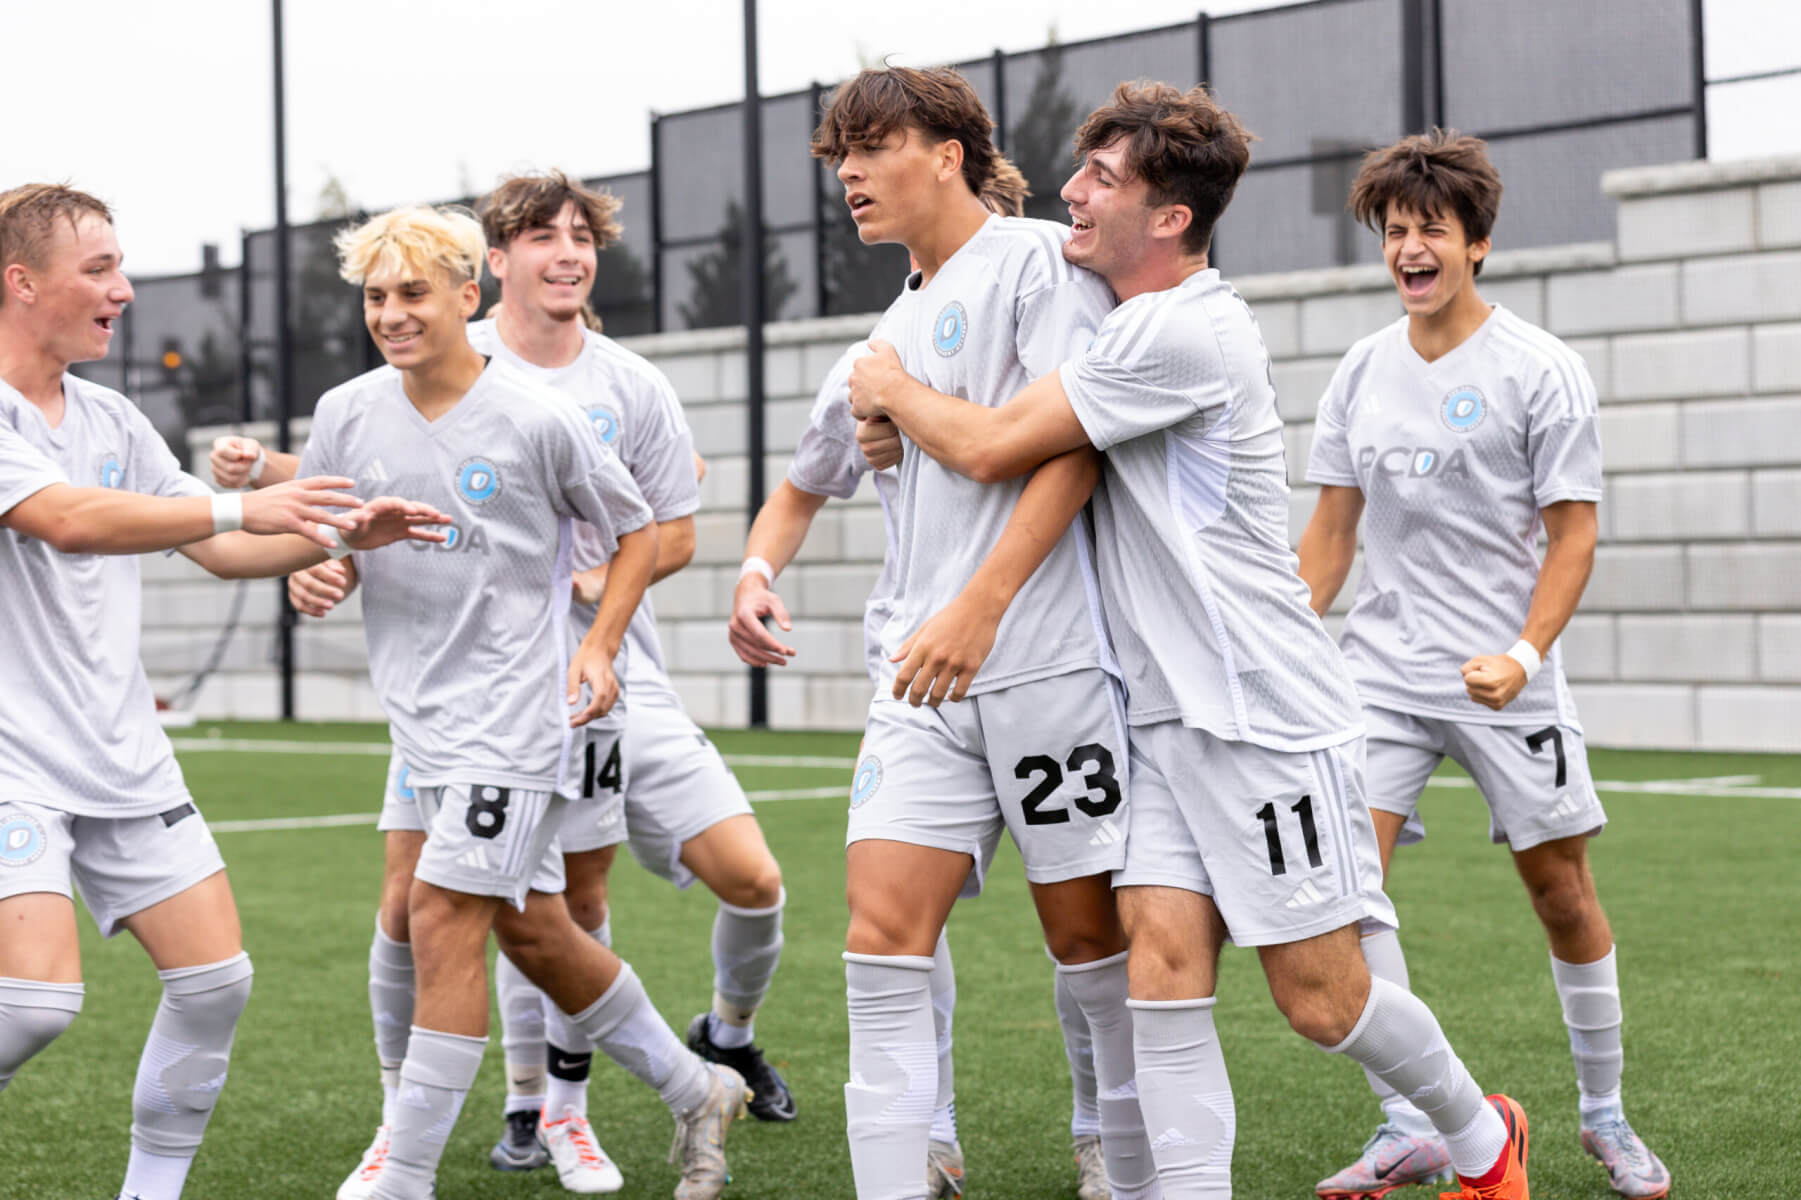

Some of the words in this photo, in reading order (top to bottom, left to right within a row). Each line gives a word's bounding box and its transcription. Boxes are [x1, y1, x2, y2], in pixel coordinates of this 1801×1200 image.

[1359, 445, 1471, 479] PCDA
[407, 522, 491, 556] CDA
[583, 738, 622, 798] 14
[1014, 743, 1122, 826] 23
[1525, 725, 1567, 789] 7
[466, 784, 510, 839] 8
[1256, 794, 1323, 876] 11
